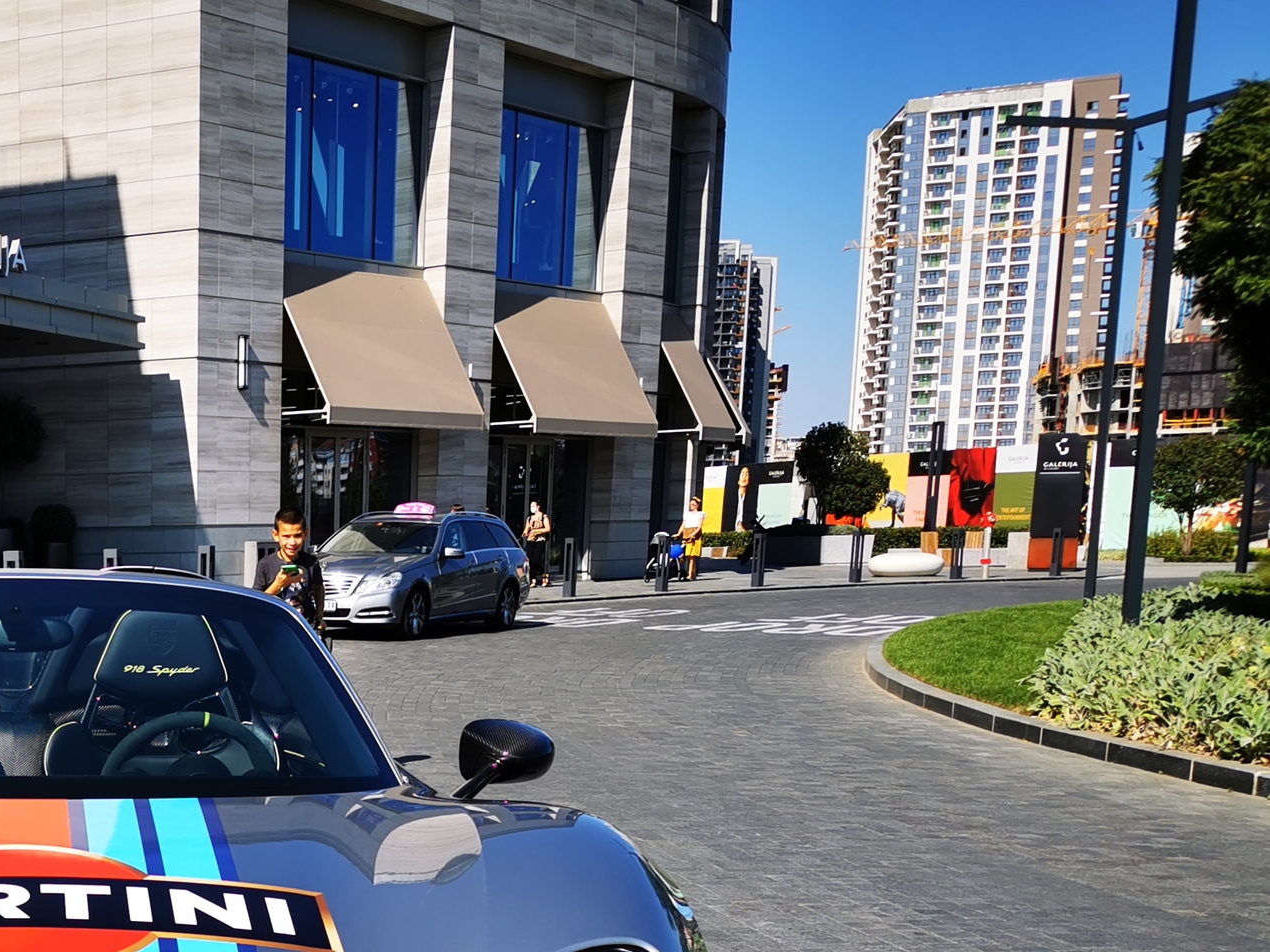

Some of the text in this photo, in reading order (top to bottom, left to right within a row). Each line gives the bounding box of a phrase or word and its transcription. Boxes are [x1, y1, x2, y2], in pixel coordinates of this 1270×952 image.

[1043, 461, 1078, 469] GALERIJA
[124, 664, 200, 677] 918 Spyder
